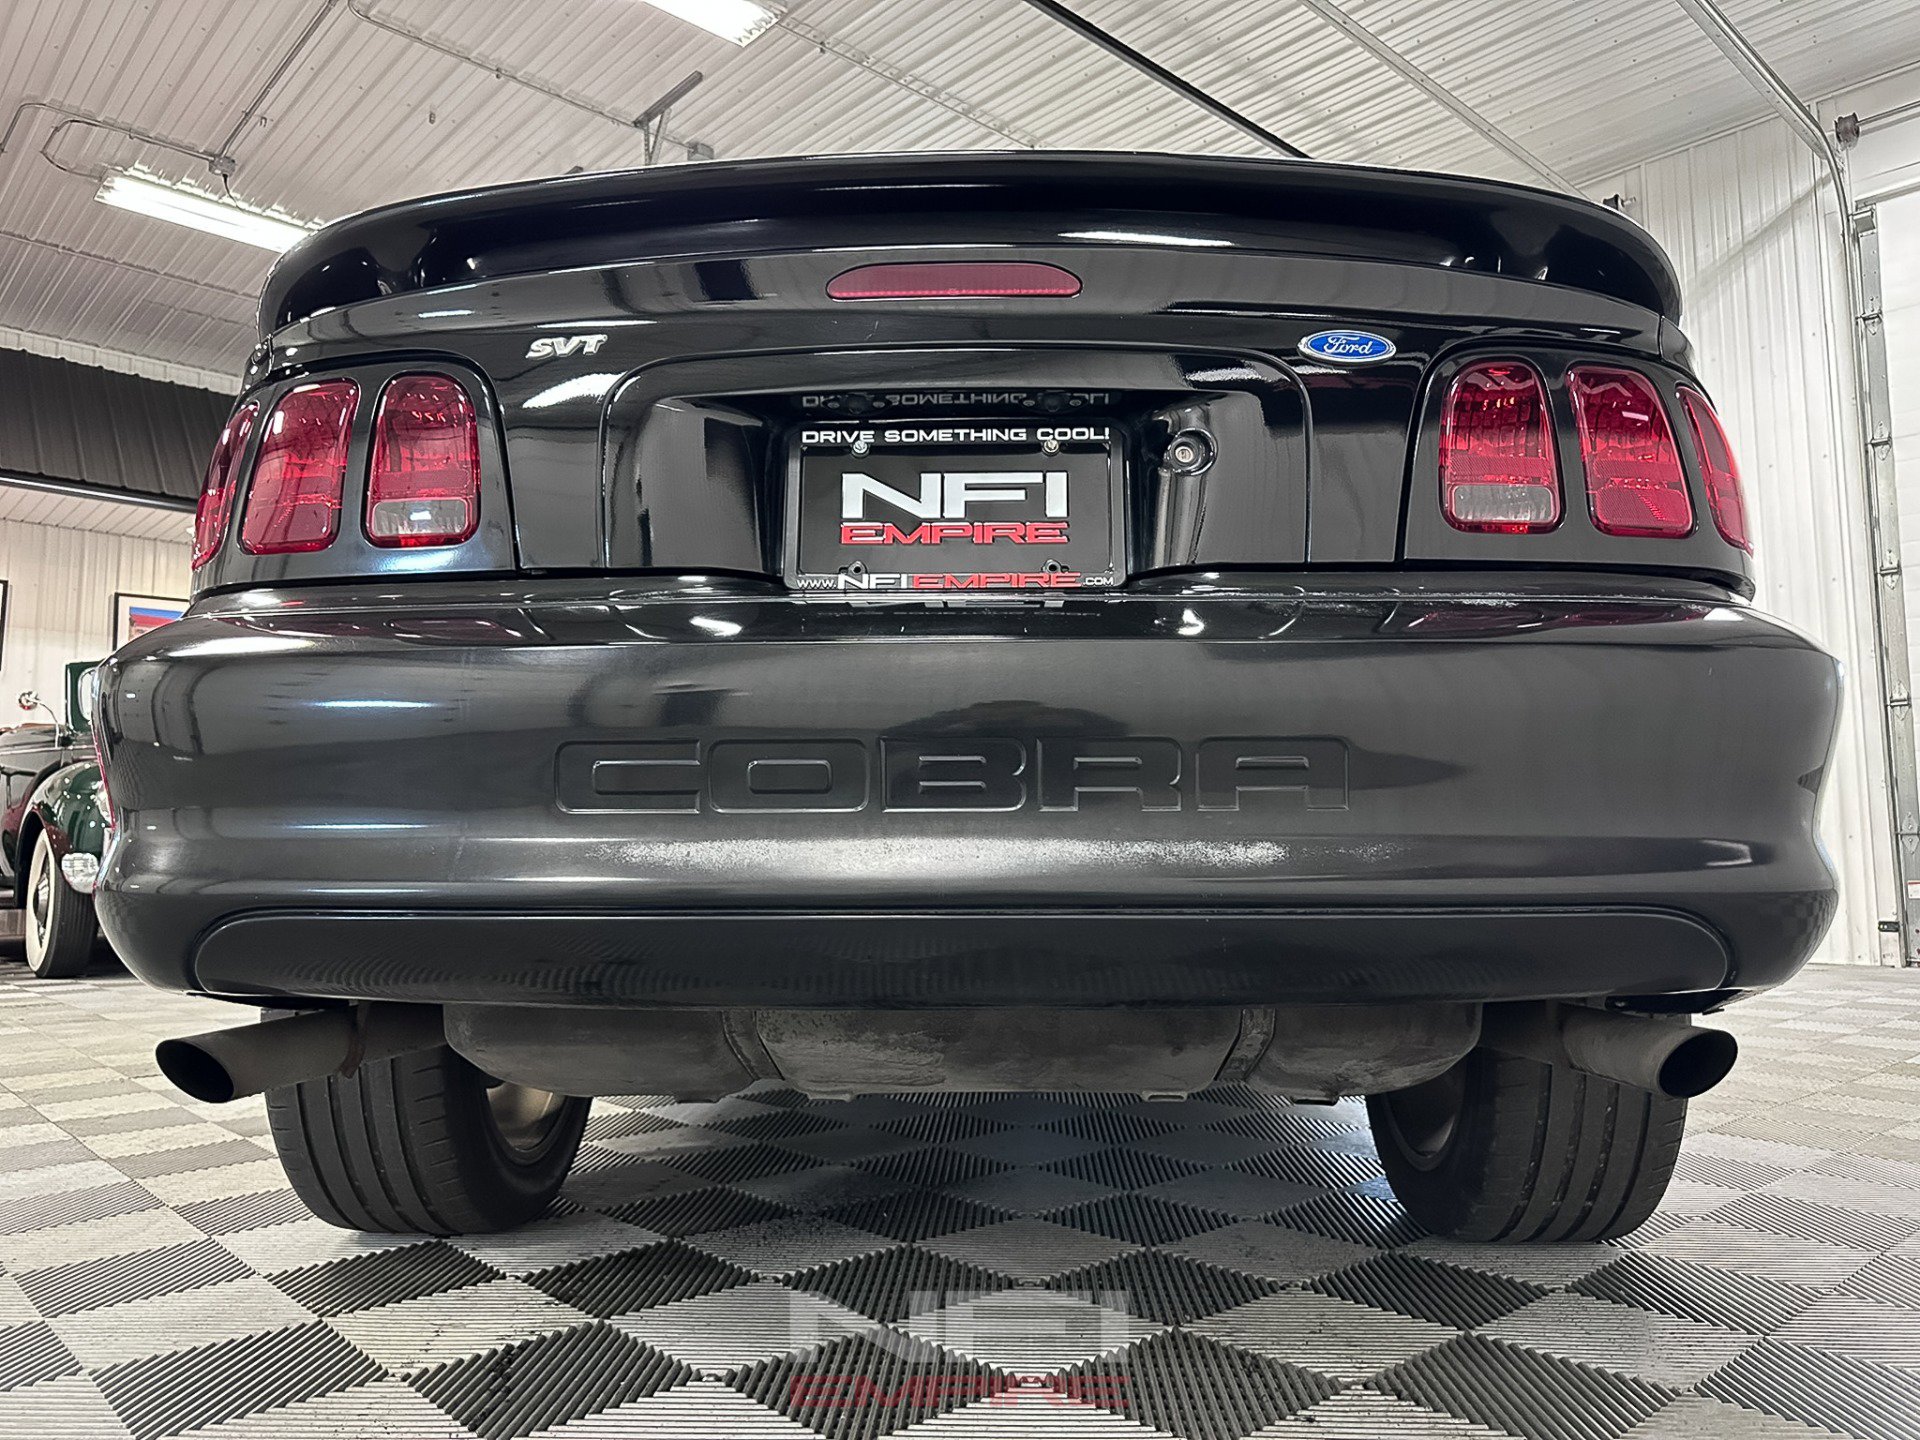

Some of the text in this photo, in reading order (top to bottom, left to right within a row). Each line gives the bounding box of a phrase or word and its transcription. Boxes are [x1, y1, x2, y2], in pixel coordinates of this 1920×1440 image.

[525, 334, 608, 360] SVT
[1323, 335, 1373, 354] Ford
[801, 427, 1110, 444] DRIVE SOMETHING COOL!
[841, 471, 1068, 519] NFI
[840, 522, 1069, 544] EMPIRE
[555, 737, 1350, 814] COBRA
